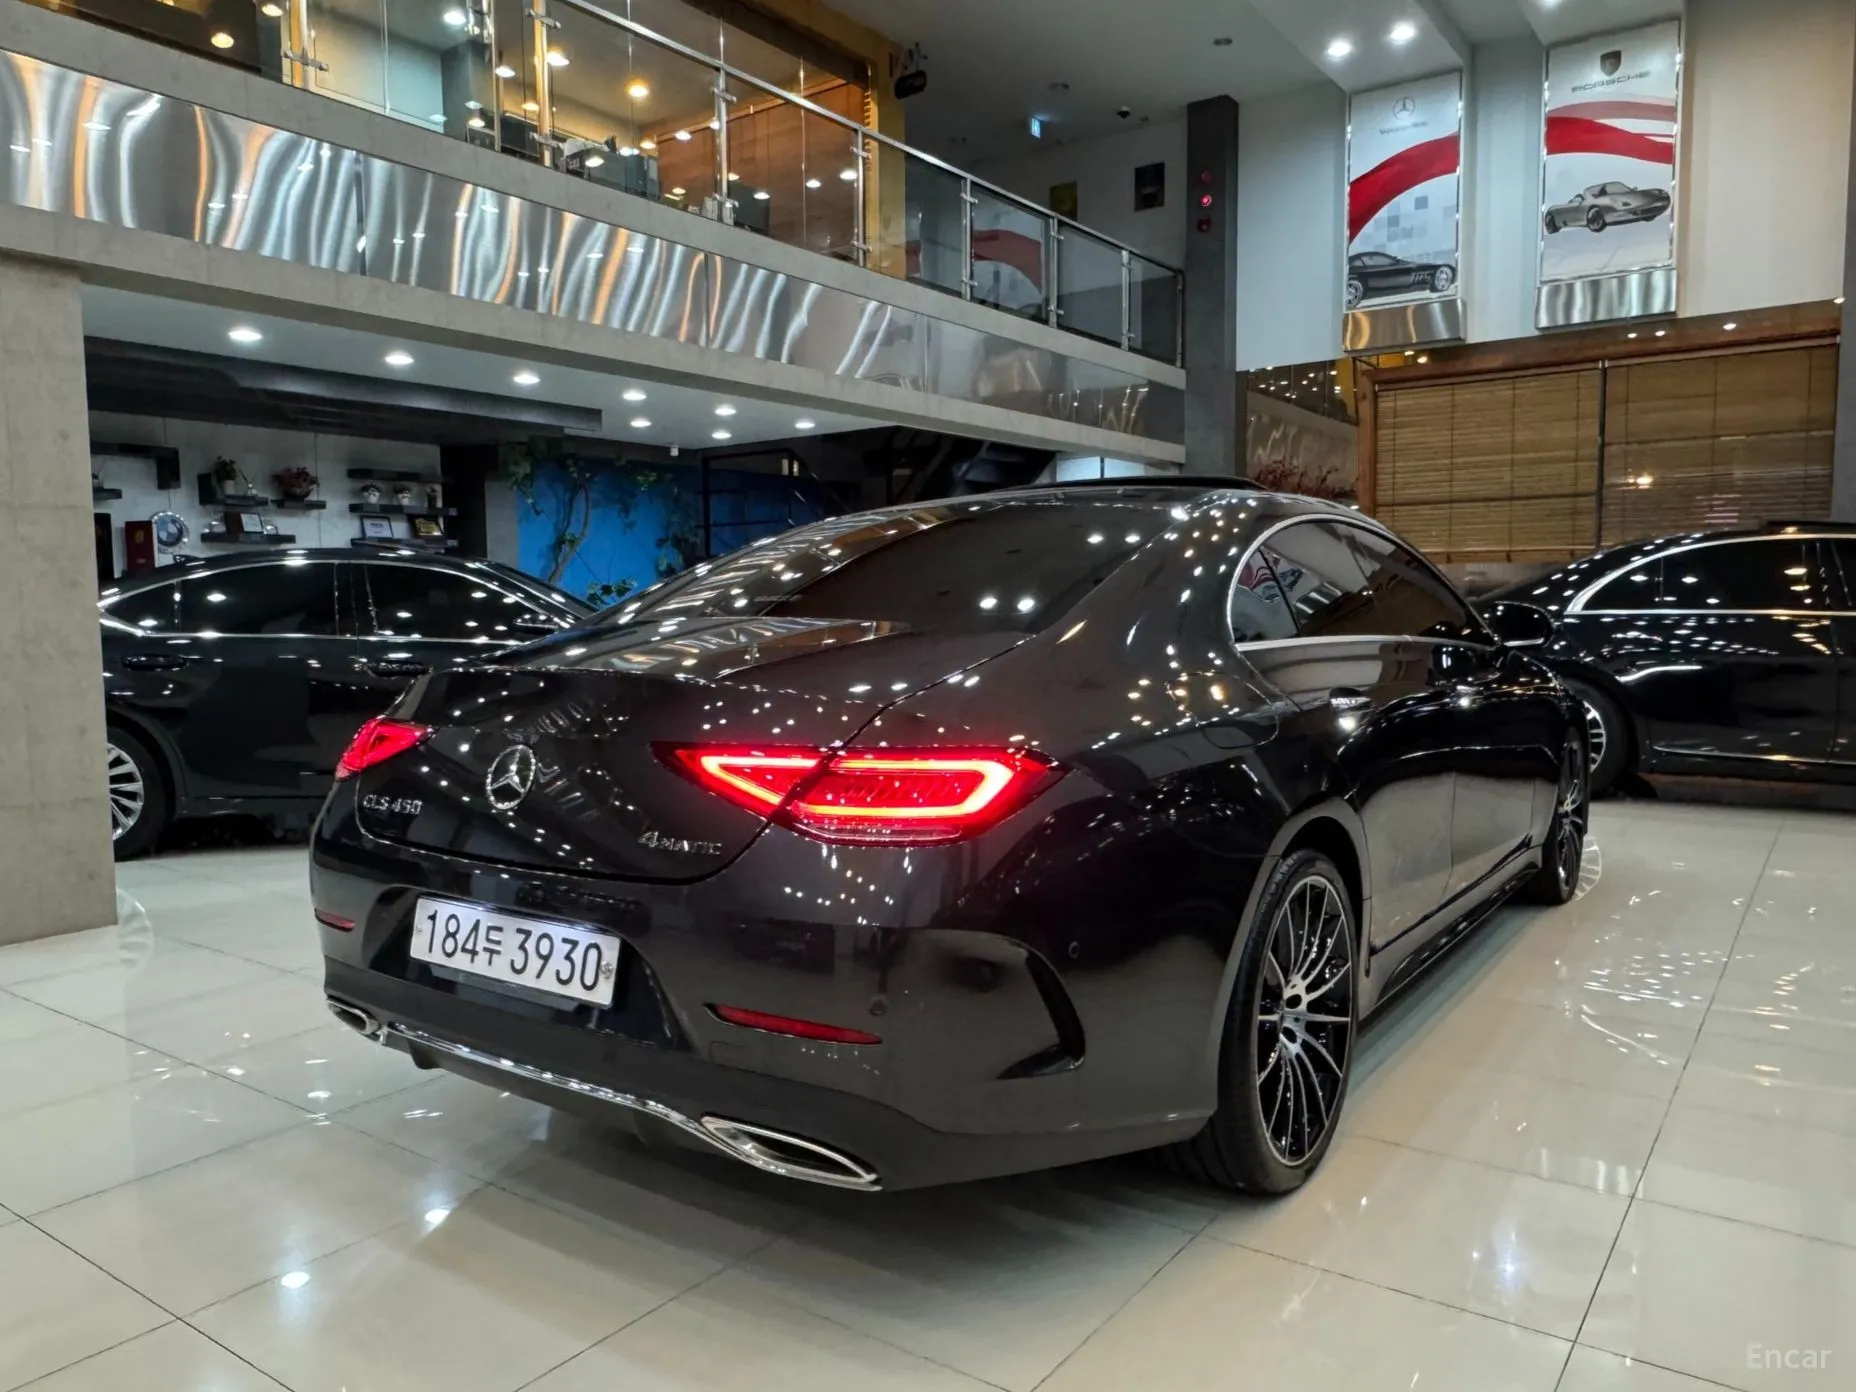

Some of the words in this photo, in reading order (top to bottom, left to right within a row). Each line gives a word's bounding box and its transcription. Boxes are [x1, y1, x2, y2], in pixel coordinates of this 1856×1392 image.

[363, 794, 390, 810] CLS
[427, 909, 504, 967] 184두
[510, 927, 603, 991] 3930
